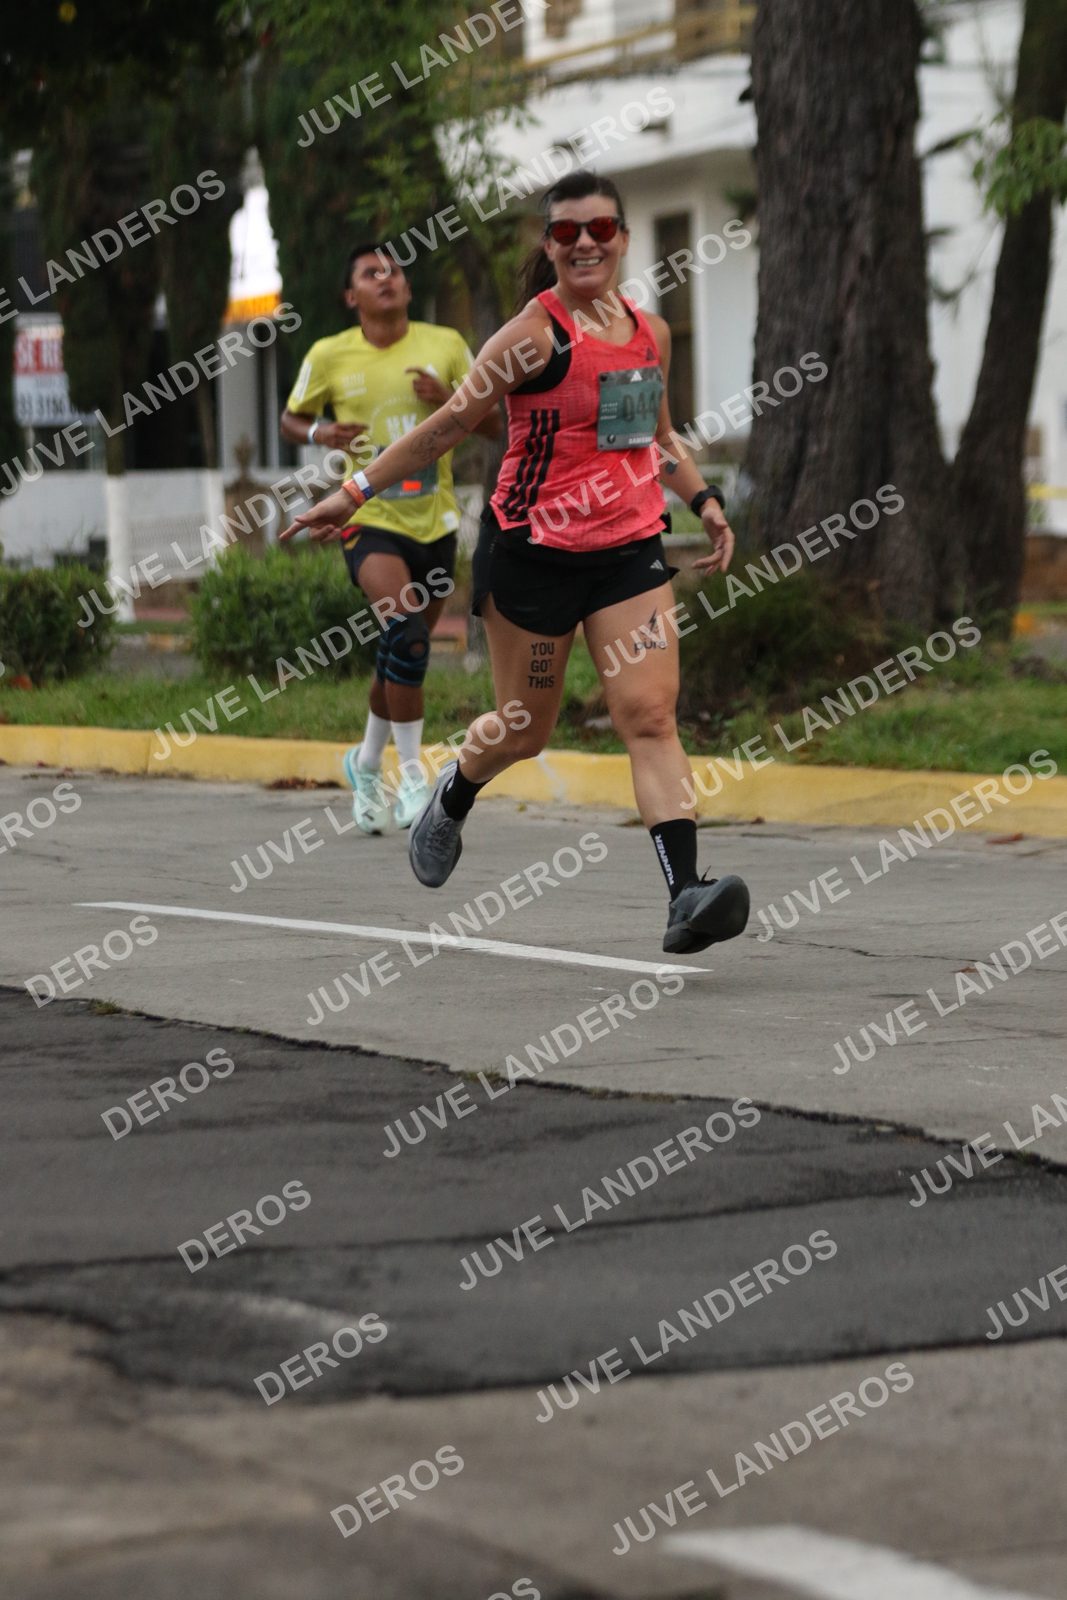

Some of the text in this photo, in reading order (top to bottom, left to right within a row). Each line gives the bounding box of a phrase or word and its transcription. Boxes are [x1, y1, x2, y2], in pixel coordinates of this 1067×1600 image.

[531, 641, 555, 657] YOU
[531, 659, 553, 673] GOT
[528, 675, 555, 689] THIS
